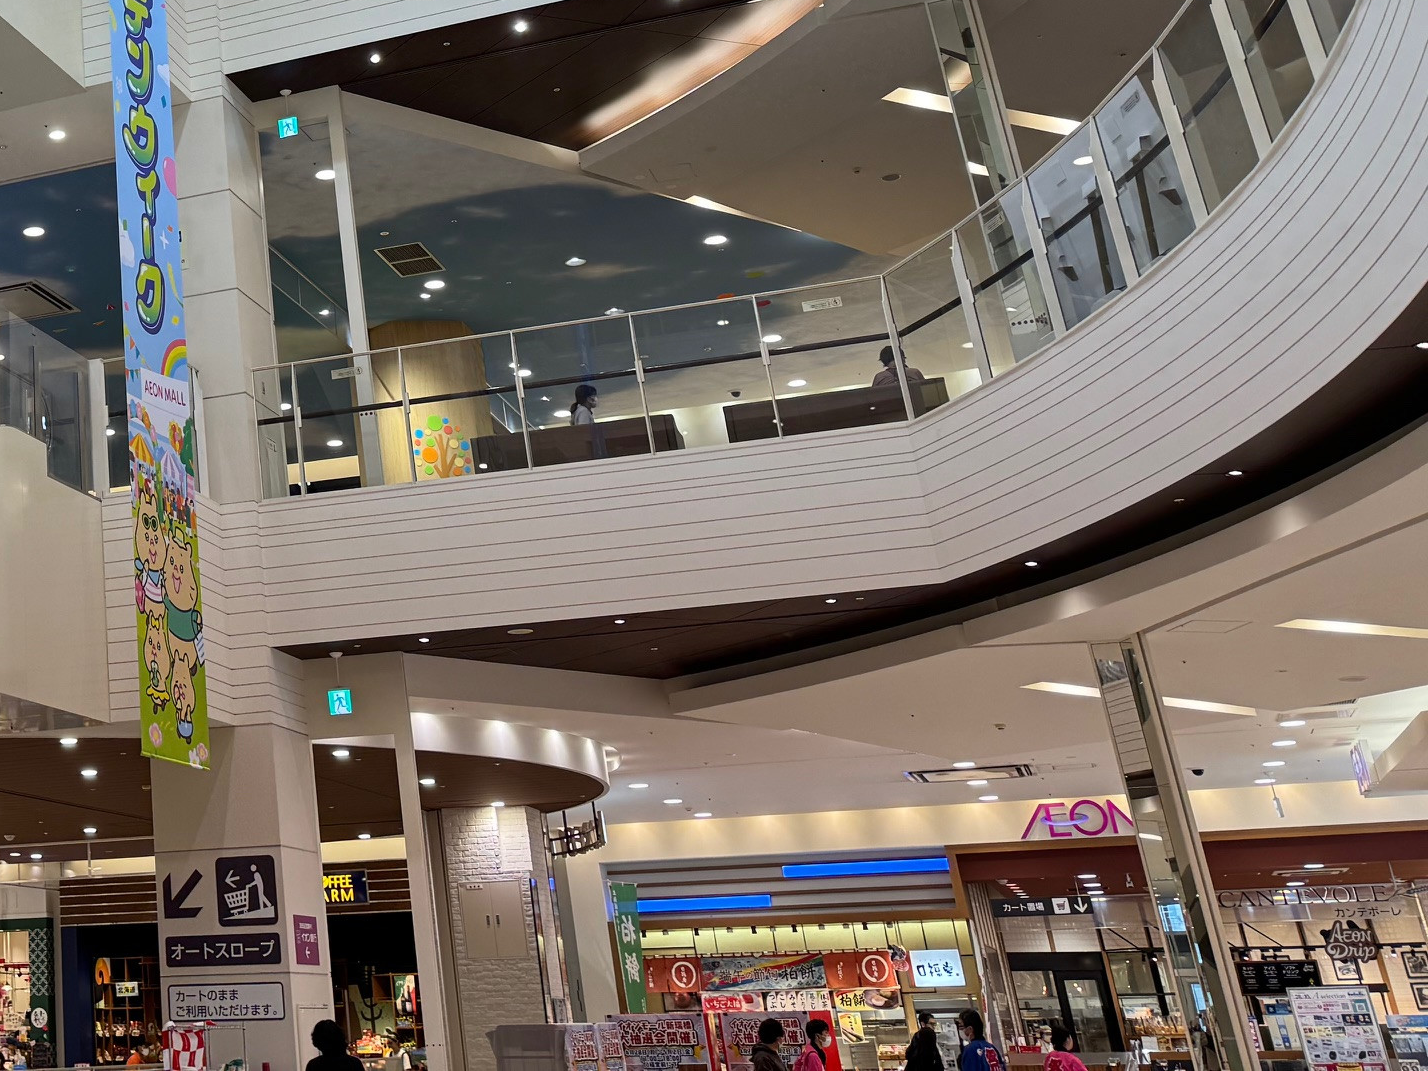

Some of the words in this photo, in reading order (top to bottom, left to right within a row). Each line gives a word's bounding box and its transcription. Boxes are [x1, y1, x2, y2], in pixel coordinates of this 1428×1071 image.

[143, 379, 164, 401] AEON
[164, 384, 187, 408] MALL
[1217, 884, 1394, 909] CANTEVOLE
[1002, 901, 1045, 913] カート置場
[1334, 907, 1401, 918] カンテボーレ
[1329, 922, 1372, 943] AEON
[170, 939, 275, 960] オートスロープ
[1326, 942, 1376, 962] Drip
[781, 964, 816, 980] 柏餅
[175, 989, 239, 1002] カートのまま
[839, 993, 866, 1008] 柏餅
[175, 1004, 278, 1018] ご利用いただけます。
[705, 1000, 741, 1009] いちご大福
